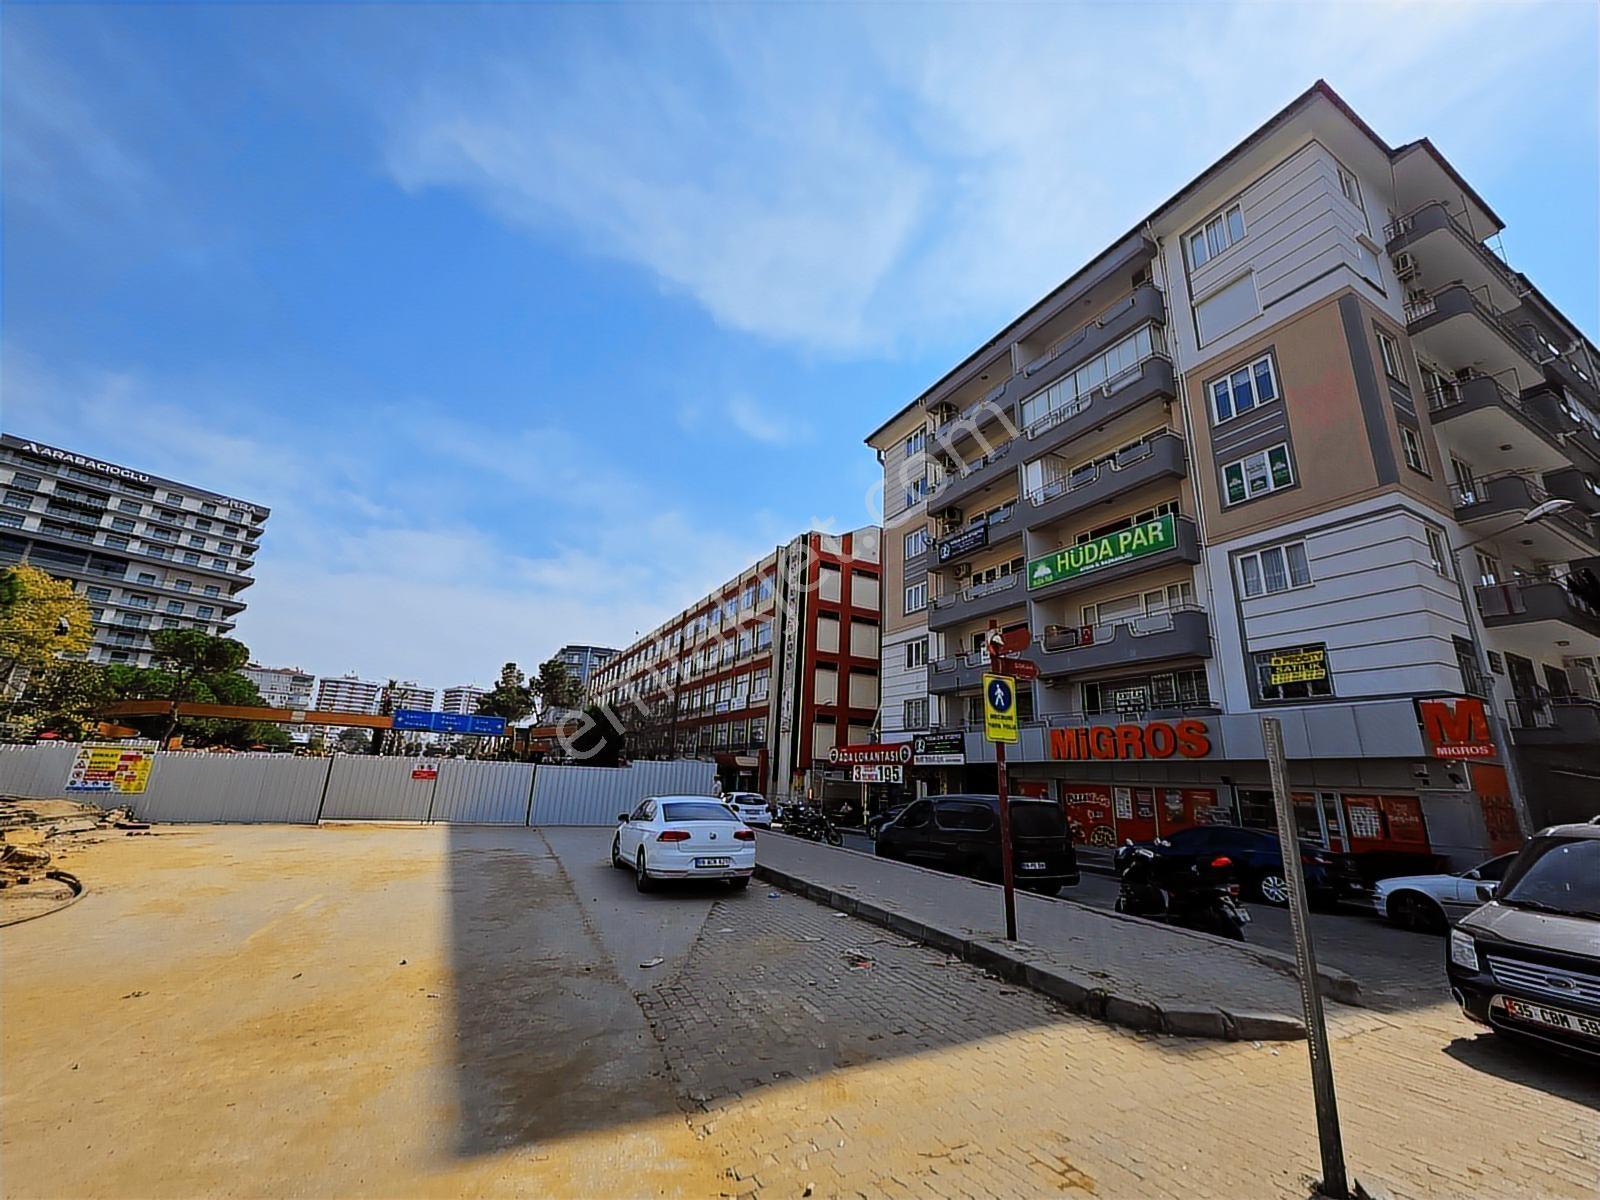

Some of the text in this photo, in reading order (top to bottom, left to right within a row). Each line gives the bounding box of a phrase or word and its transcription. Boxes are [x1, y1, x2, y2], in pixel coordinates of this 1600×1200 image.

[1057, 521, 1165, 573] HÜDA PAR
[839, 750, 899, 763] ADA LOKANTASI
[854, 766, 862, 780] 3
[878, 765, 901, 782] 195
[1513, 1002, 1534, 1018] 35
[1540, 1008, 1572, 1028] CBM
